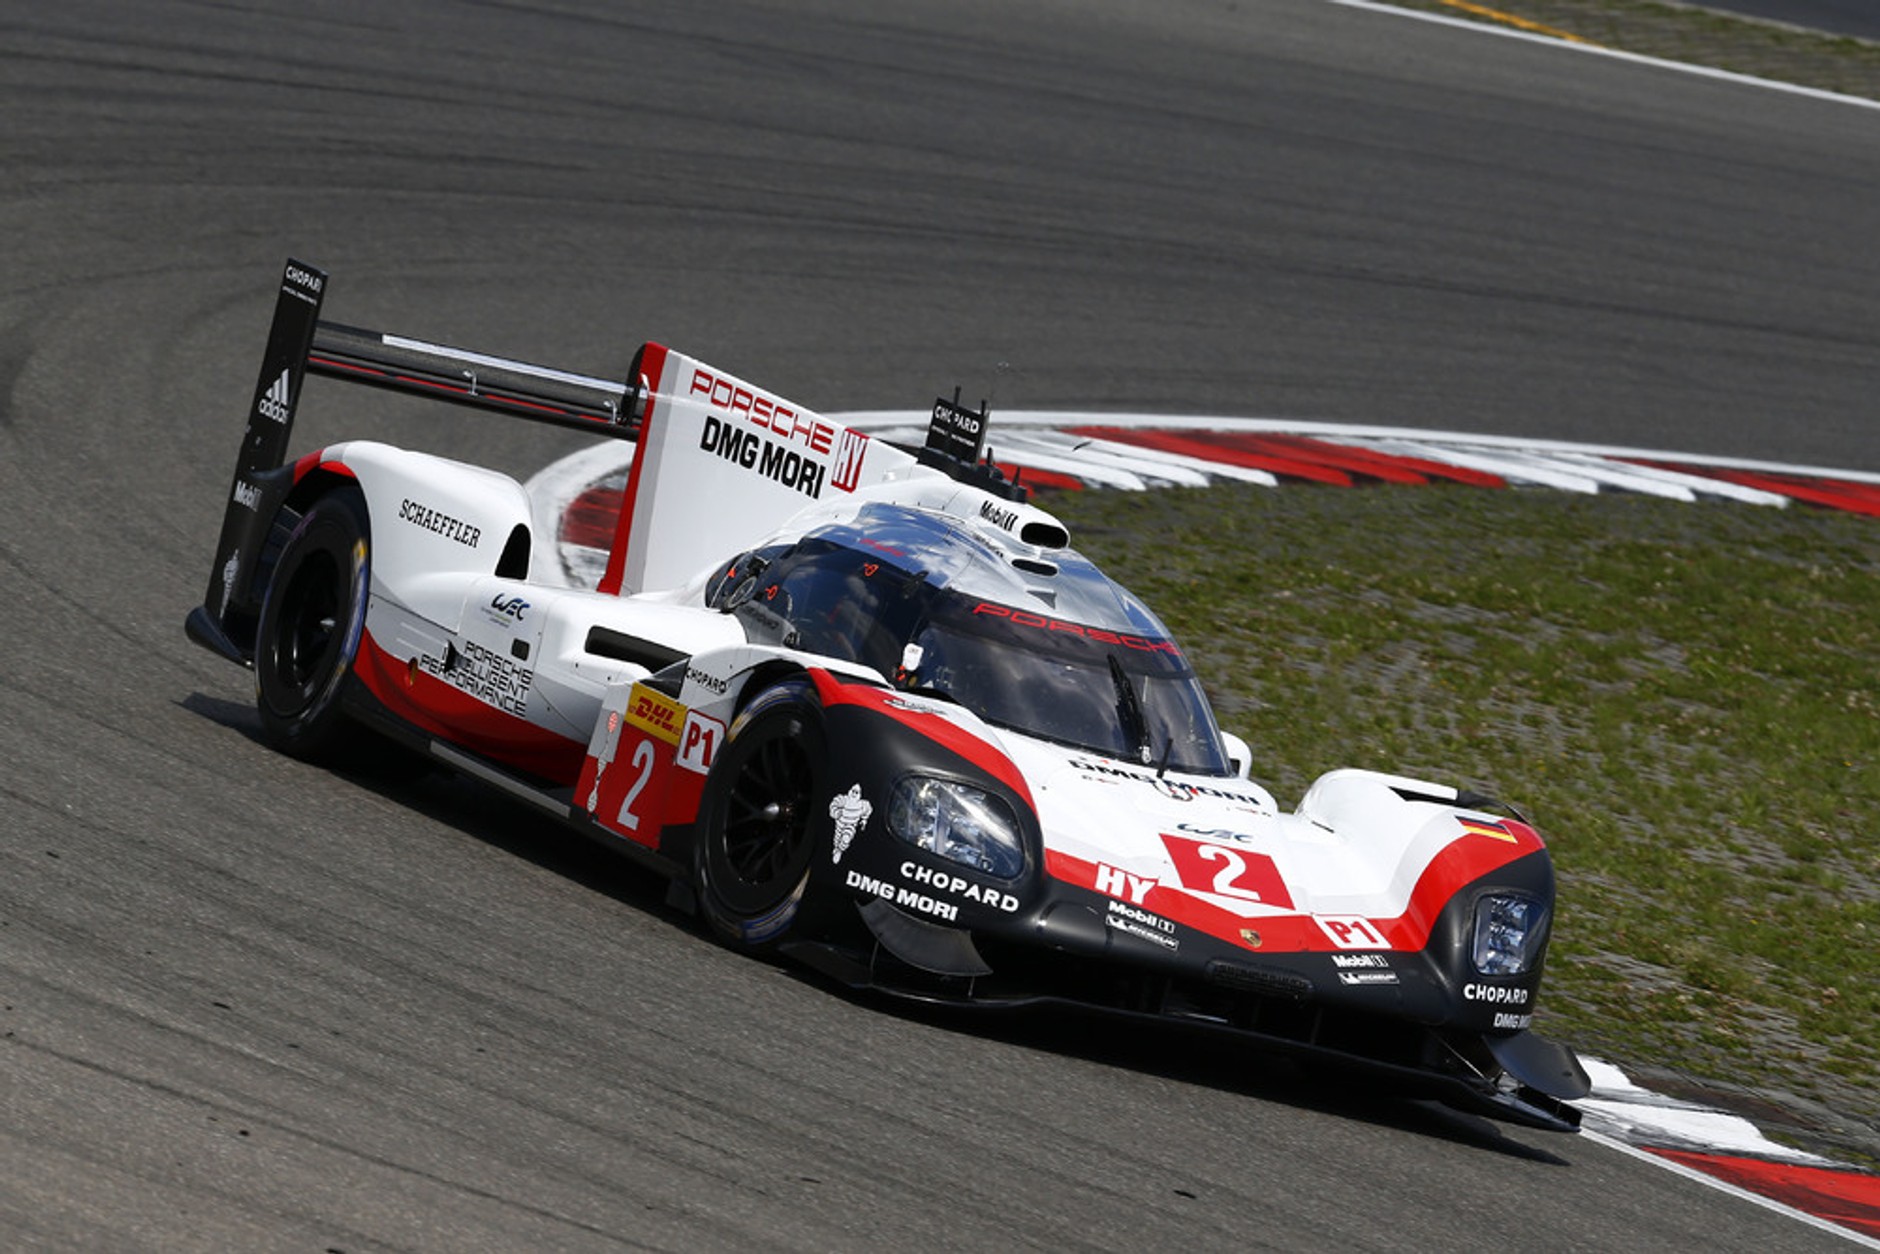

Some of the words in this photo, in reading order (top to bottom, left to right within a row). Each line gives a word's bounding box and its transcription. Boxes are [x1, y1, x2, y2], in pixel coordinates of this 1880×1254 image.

[258, 398, 289, 424] adidas
[690, 369, 834, 455] PORSCHE
[700, 416, 760, 469] DMG
[758, 440, 826, 500] MORI
[399, 498, 481, 548] SCHAEFFLER
[980, 500, 1007, 528] Mobil
[490, 593, 531, 621] WEC
[464, 641, 533, 686] PORSCHE
[686, 667, 727, 694] CHOPARD
[635, 696, 675, 732] DHL
[683, 721, 714, 768] P1
[616, 739, 655, 831] 2
[901, 861, 1019, 912] CHOPARD
[1095, 864, 1158, 905] HY
[1198, 844, 1261, 901] 2
[846, 870, 896, 900] DMG
[897, 888, 958, 921] MORI
[1108, 900, 1158, 926] Mobil
[1324, 920, 1379, 943] P1
[1331, 955, 1375, 967] Mobil
[1463, 983, 1529, 1005] CHOPARD
[1494, 1012, 1520, 1029] DMG
